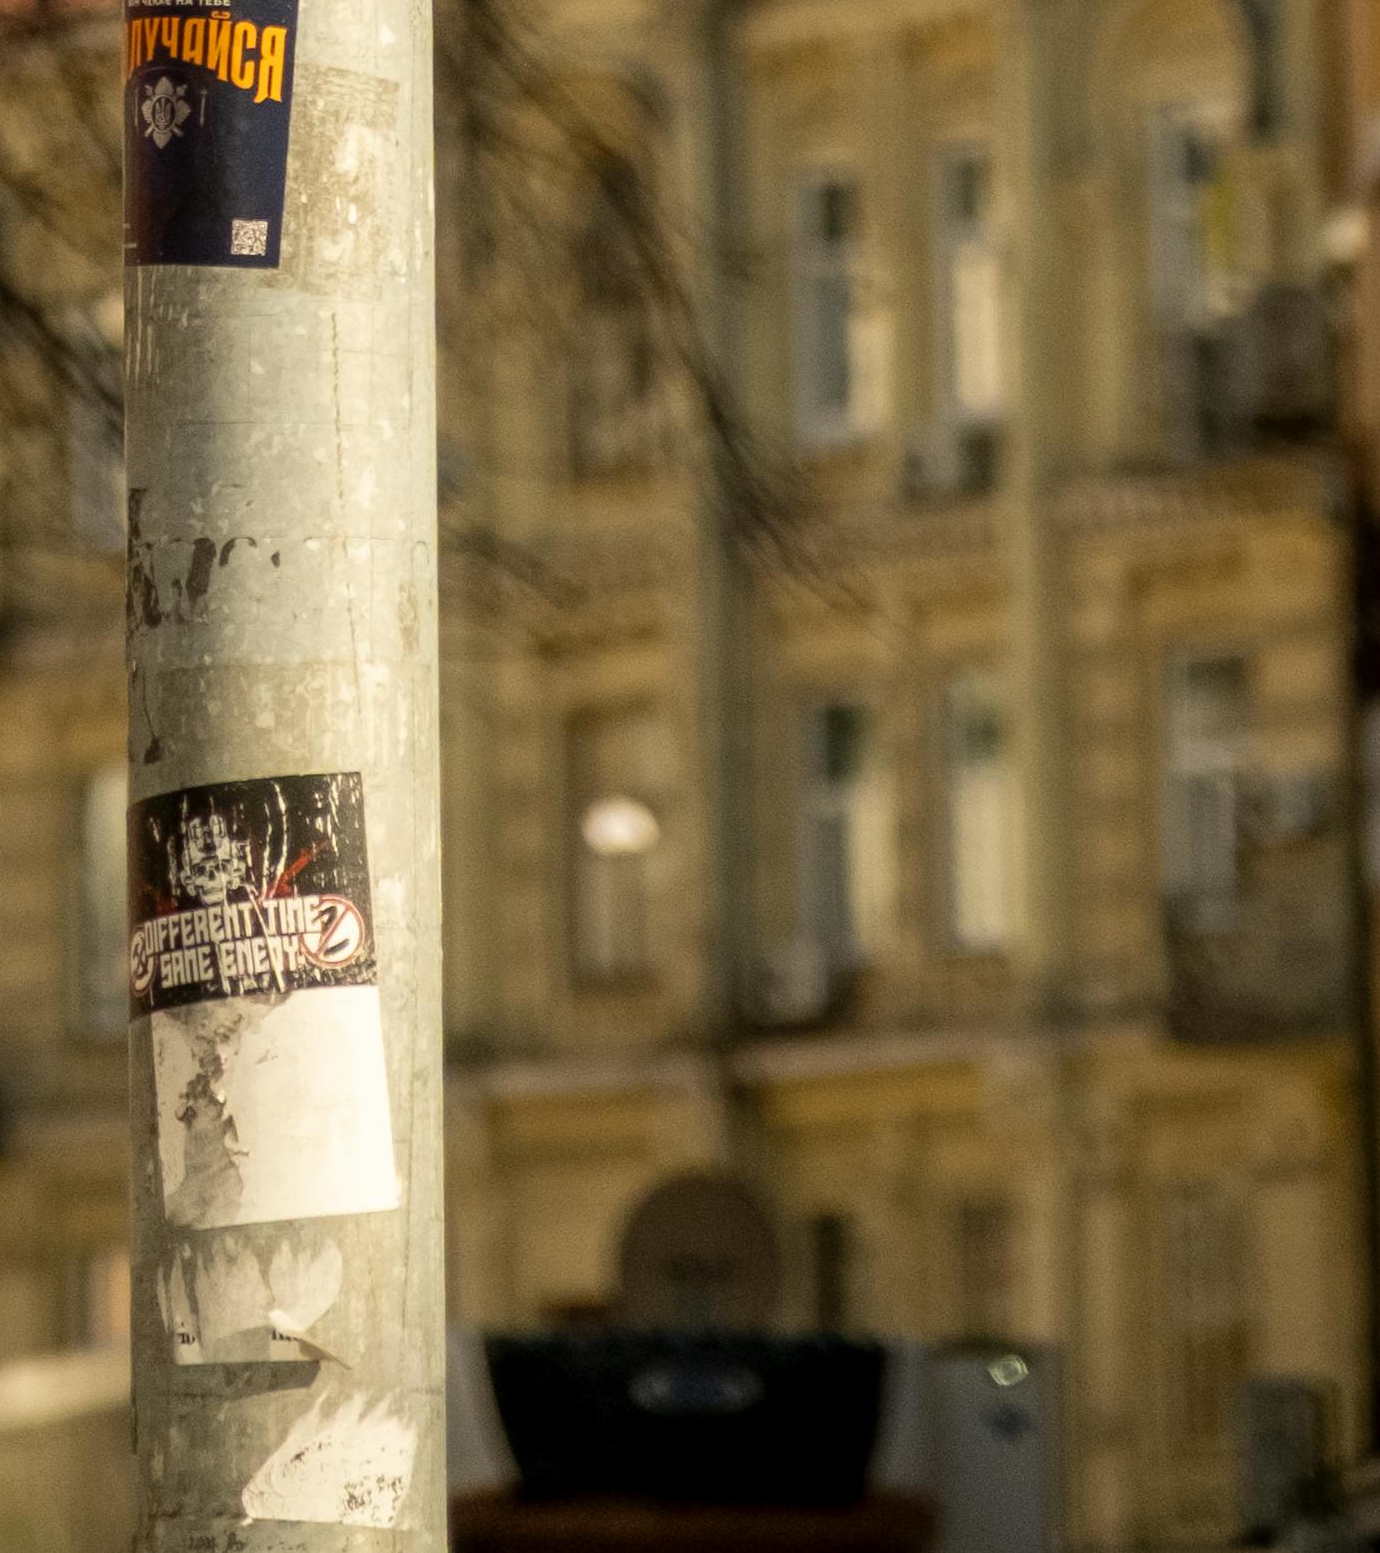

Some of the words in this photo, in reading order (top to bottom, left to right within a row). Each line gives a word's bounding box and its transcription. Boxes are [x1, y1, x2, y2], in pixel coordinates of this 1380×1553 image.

[125, 10, 287, 104] ЛУЧАЙСЯ
[144, 902, 253, 955] DIFFERENT
[262, 896, 321, 935] TIME
[160, 943, 214, 989] SAME
